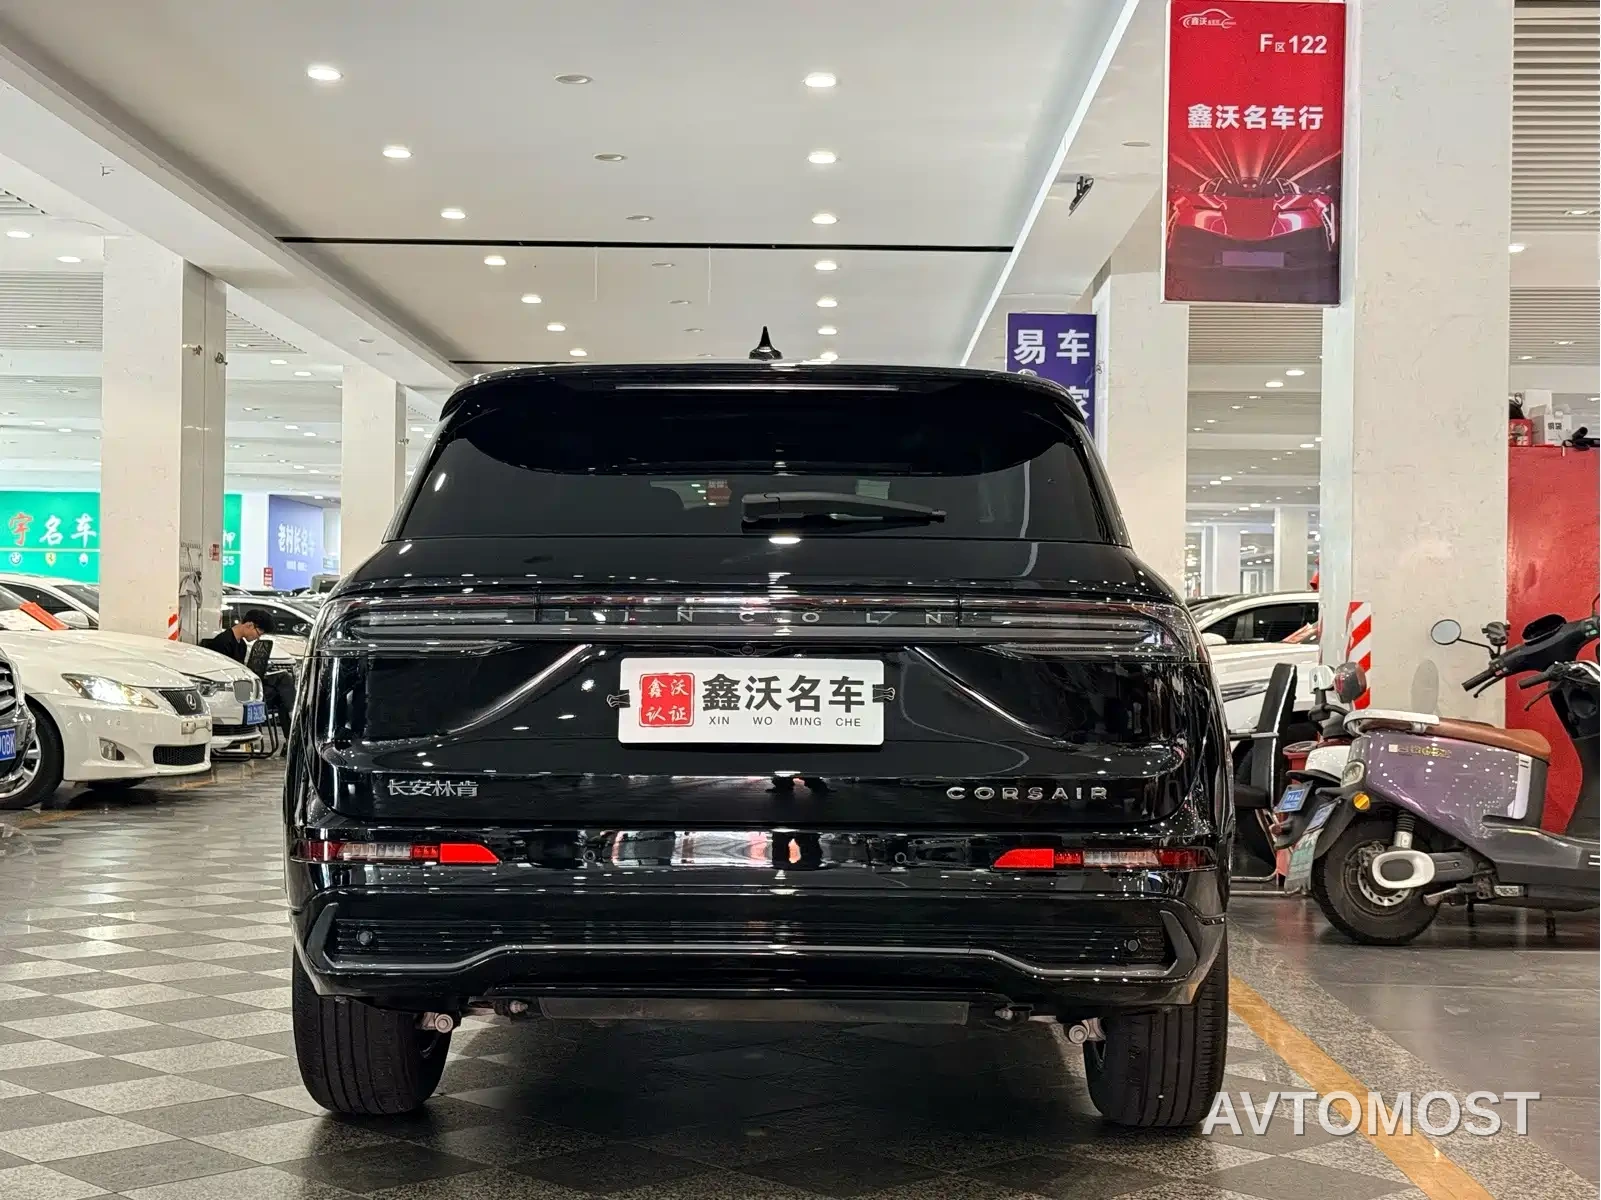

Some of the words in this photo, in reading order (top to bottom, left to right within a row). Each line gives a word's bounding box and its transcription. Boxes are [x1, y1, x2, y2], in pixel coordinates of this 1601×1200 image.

[1187, 103, 1324, 130] 鑫沃名车行
[564, 610, 943, 624] LINCOLN
[647, 677, 690, 699] 鑫沃
[702, 673, 866, 713] 鑫沃名车
[645, 704, 688, 723] 认证
[708, 716, 730, 726] XIN
[752, 716, 773, 726] WO
[789, 716, 822, 727] MING
[836, 717, 862, 727] CHE
[387, 779, 479, 797] 长安林肯
[946, 786, 1108, 800] CORSAIR
